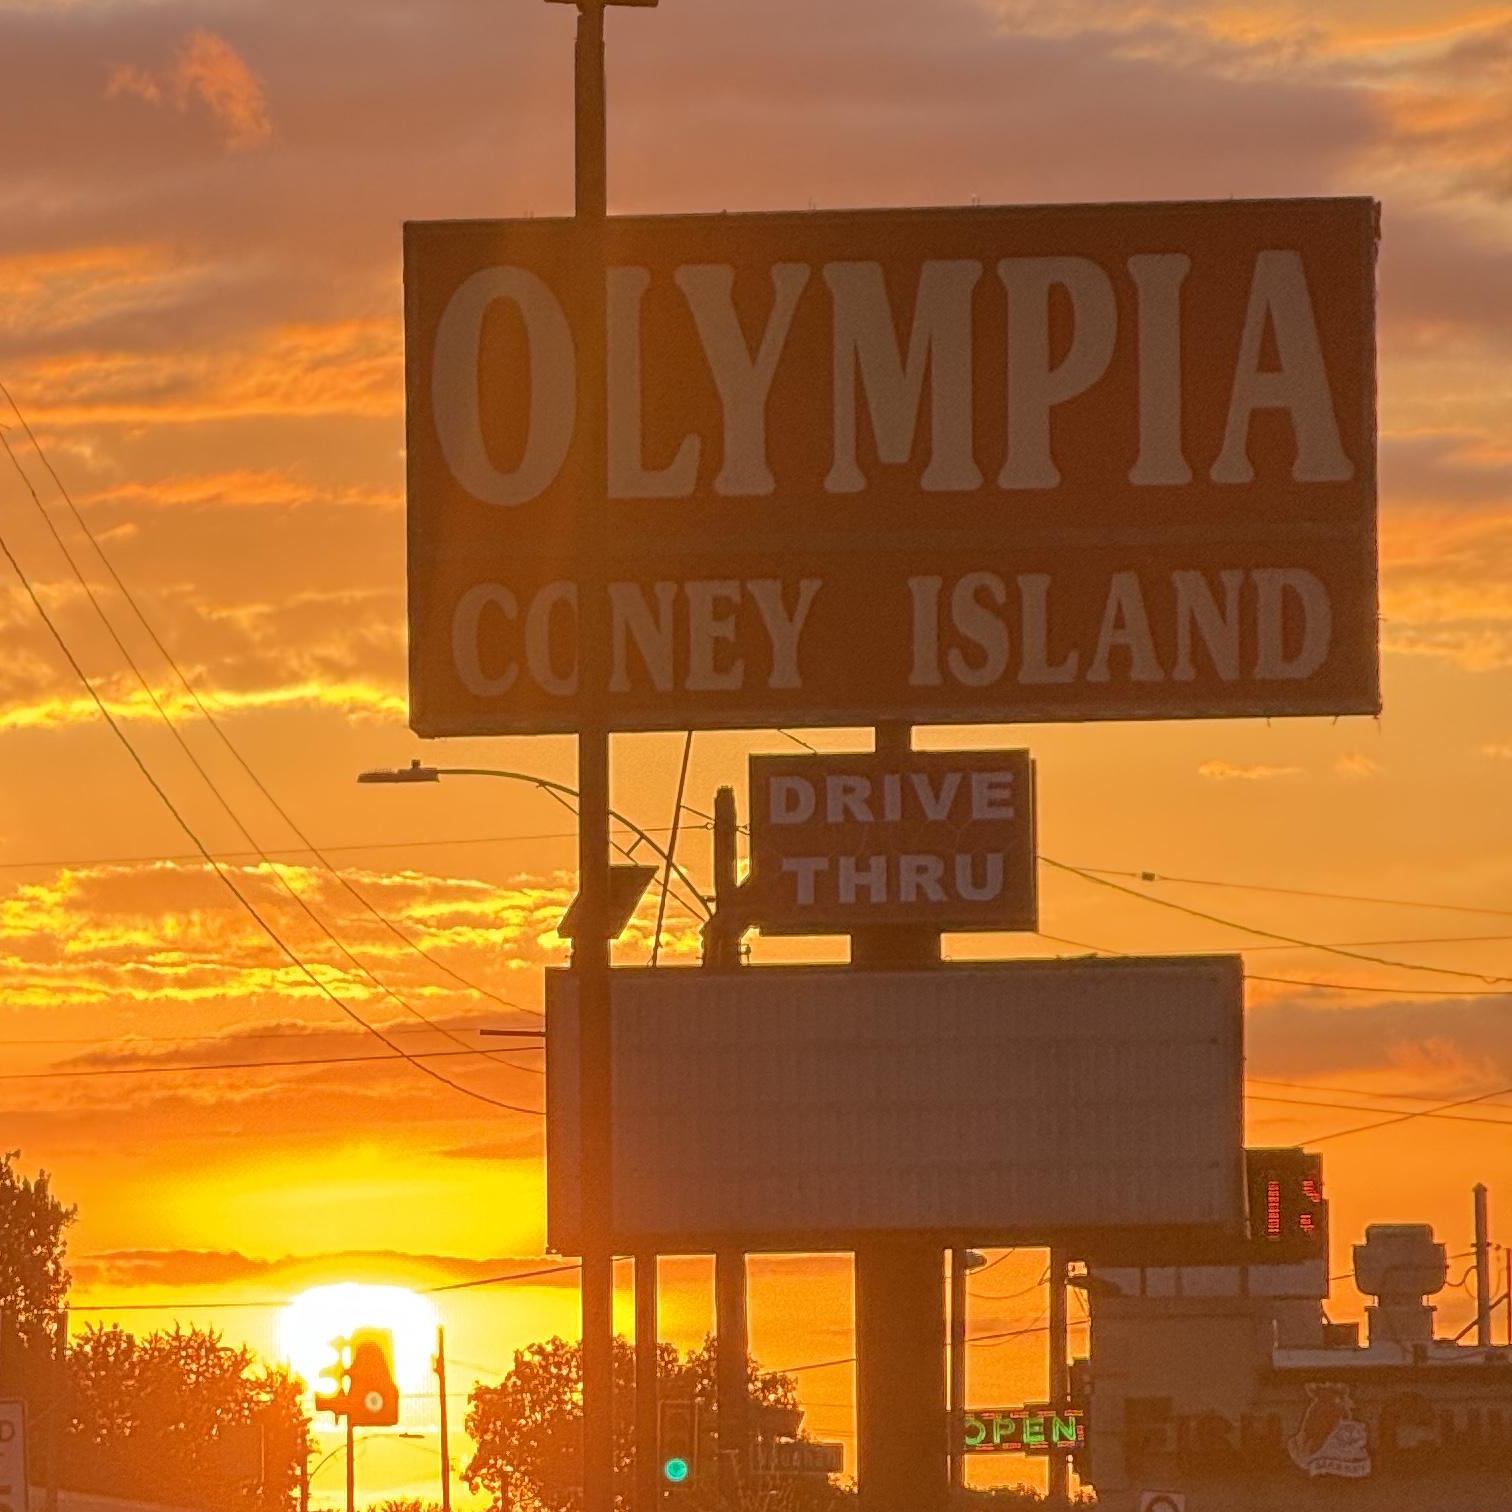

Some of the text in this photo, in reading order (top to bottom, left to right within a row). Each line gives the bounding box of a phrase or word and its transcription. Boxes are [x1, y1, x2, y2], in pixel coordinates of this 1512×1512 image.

[432, 249, 1354, 507] OLYMPIA
[452, 567, 1332, 697] CONEY ISLAND
[769, 770, 1015, 826] DRIVE
[783, 852, 1004, 906] THRU
[964, 1417, 1077, 1445] OPEN
